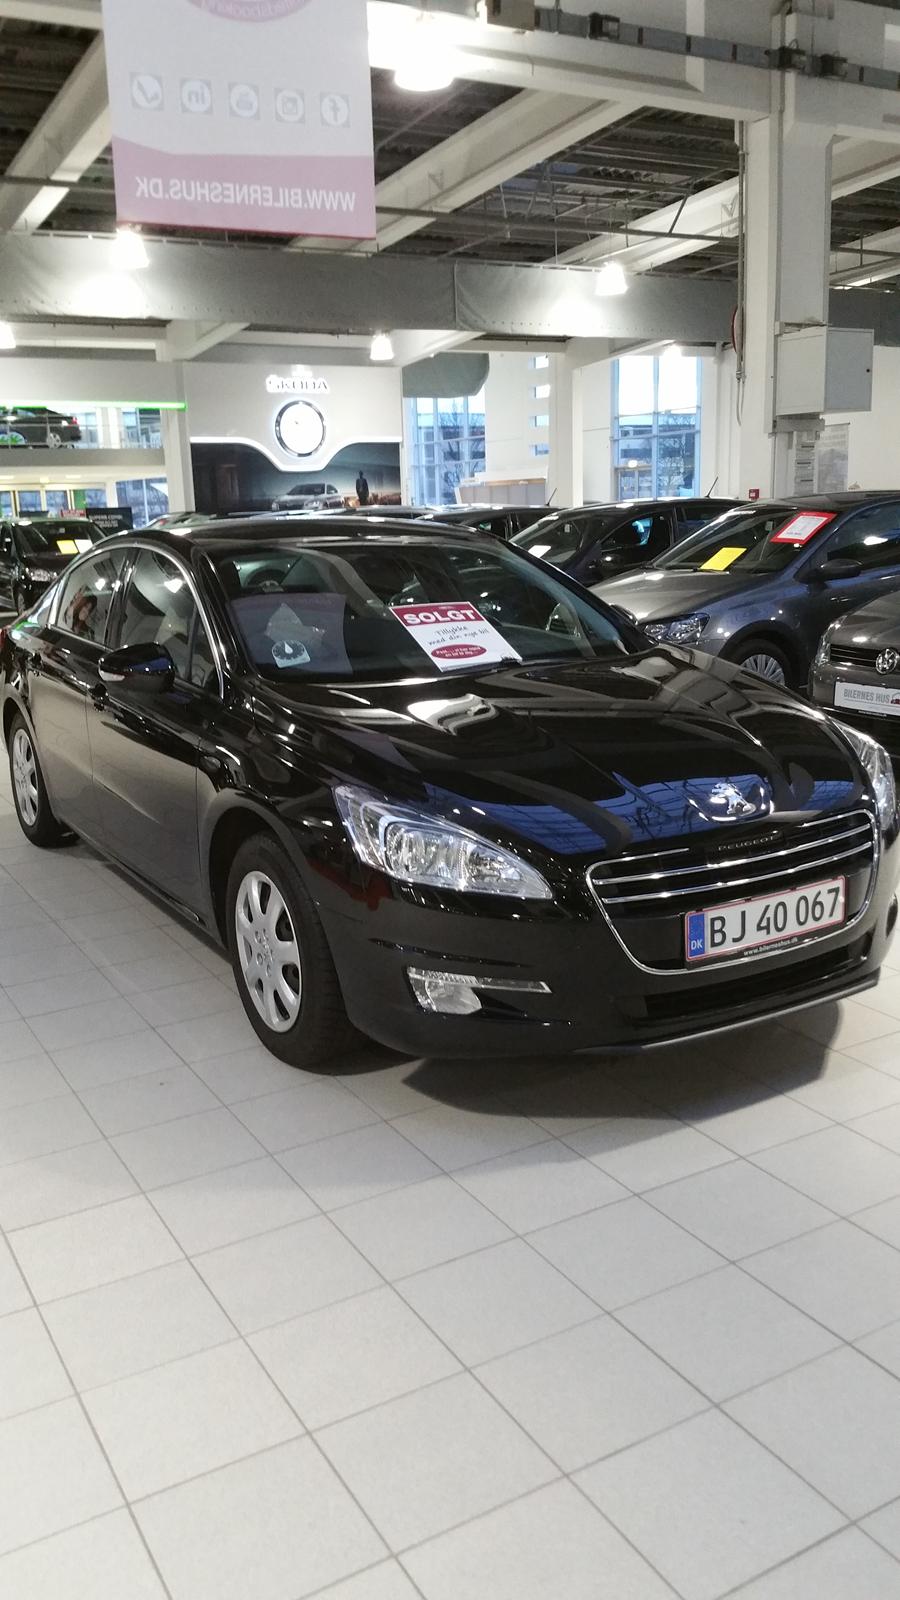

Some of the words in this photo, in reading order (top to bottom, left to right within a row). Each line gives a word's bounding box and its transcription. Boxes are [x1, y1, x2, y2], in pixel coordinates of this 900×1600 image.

[403, 609, 474, 625] SOLGT
[843, 688, 874, 702] BILERNES
[875, 692, 890, 704] HUS
[719, 835, 774, 850] PEUGEOT
[709, 910, 746, 949] BJ
[756, 901, 788, 936] 40
[795, 886, 840, 926] 067
[690, 937, 703, 951] DK
